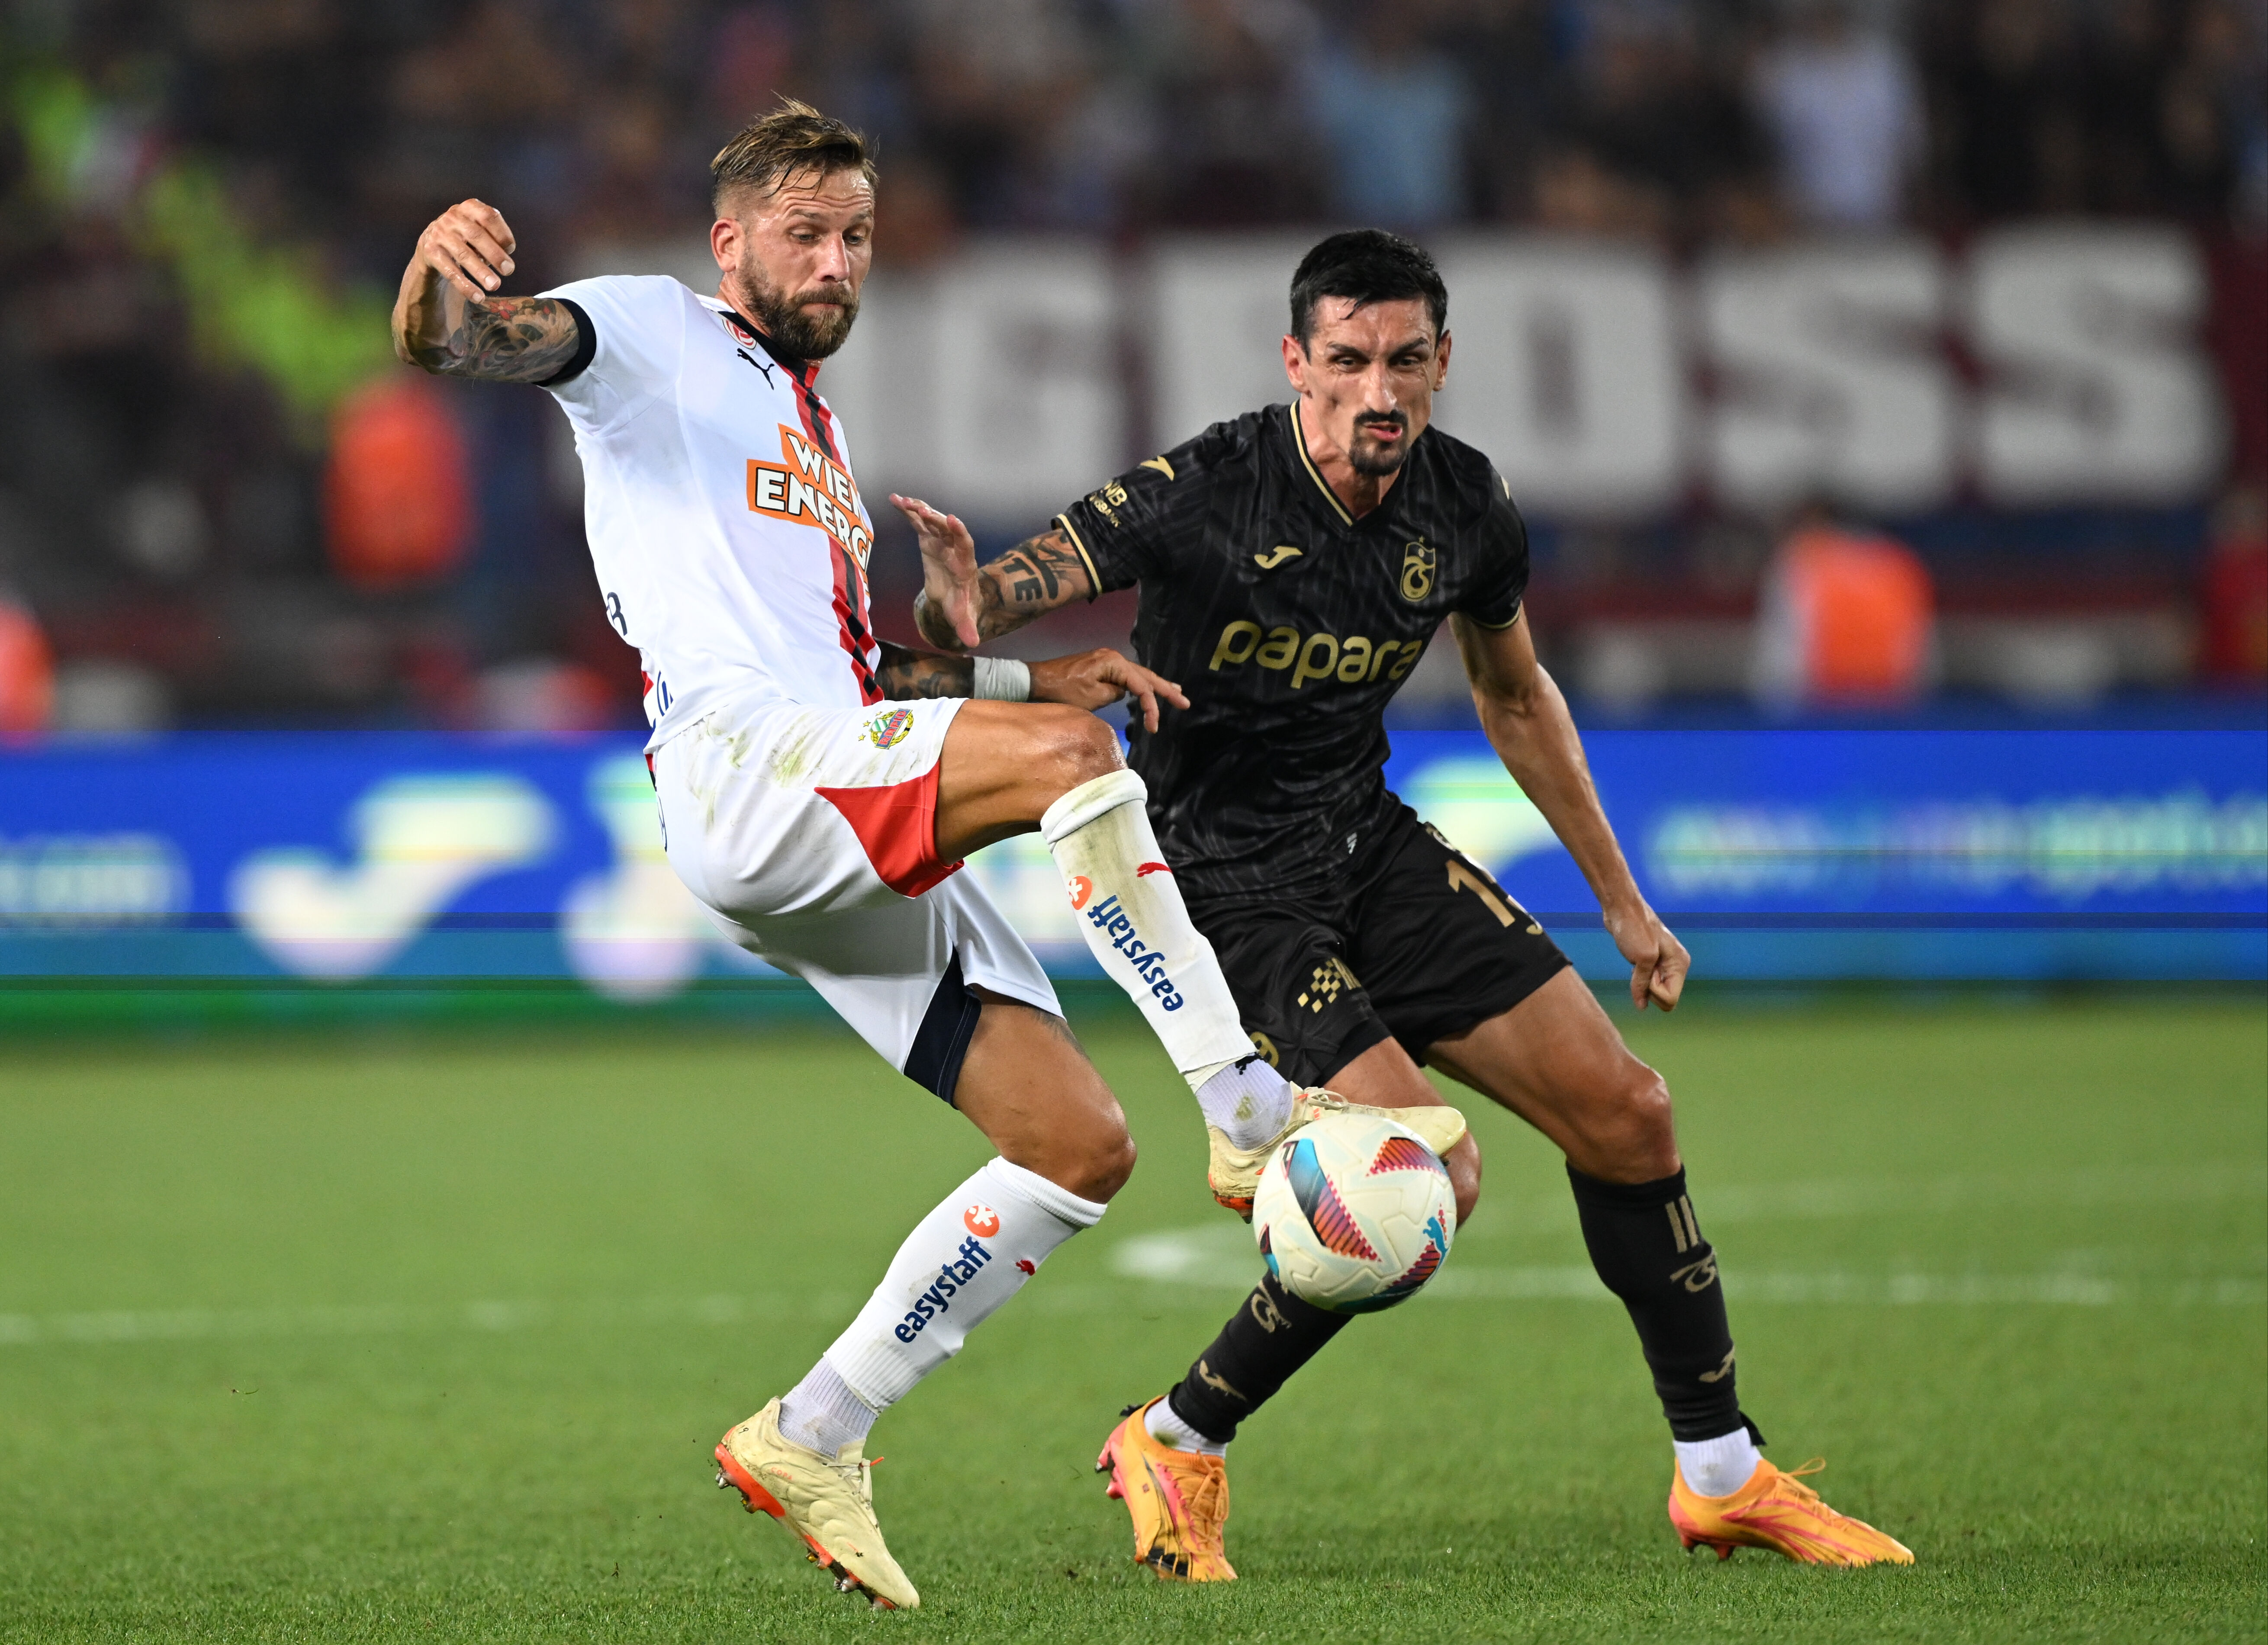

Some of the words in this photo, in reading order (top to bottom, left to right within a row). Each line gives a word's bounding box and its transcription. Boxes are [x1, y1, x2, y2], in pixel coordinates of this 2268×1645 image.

[1100, 479, 1127, 506] NB
[1209, 620, 1422, 689] papara
[878, 710, 907, 745] RAPID
[1087, 894, 1184, 1012] easystaff
[895, 1236, 992, 1343] easystaff
